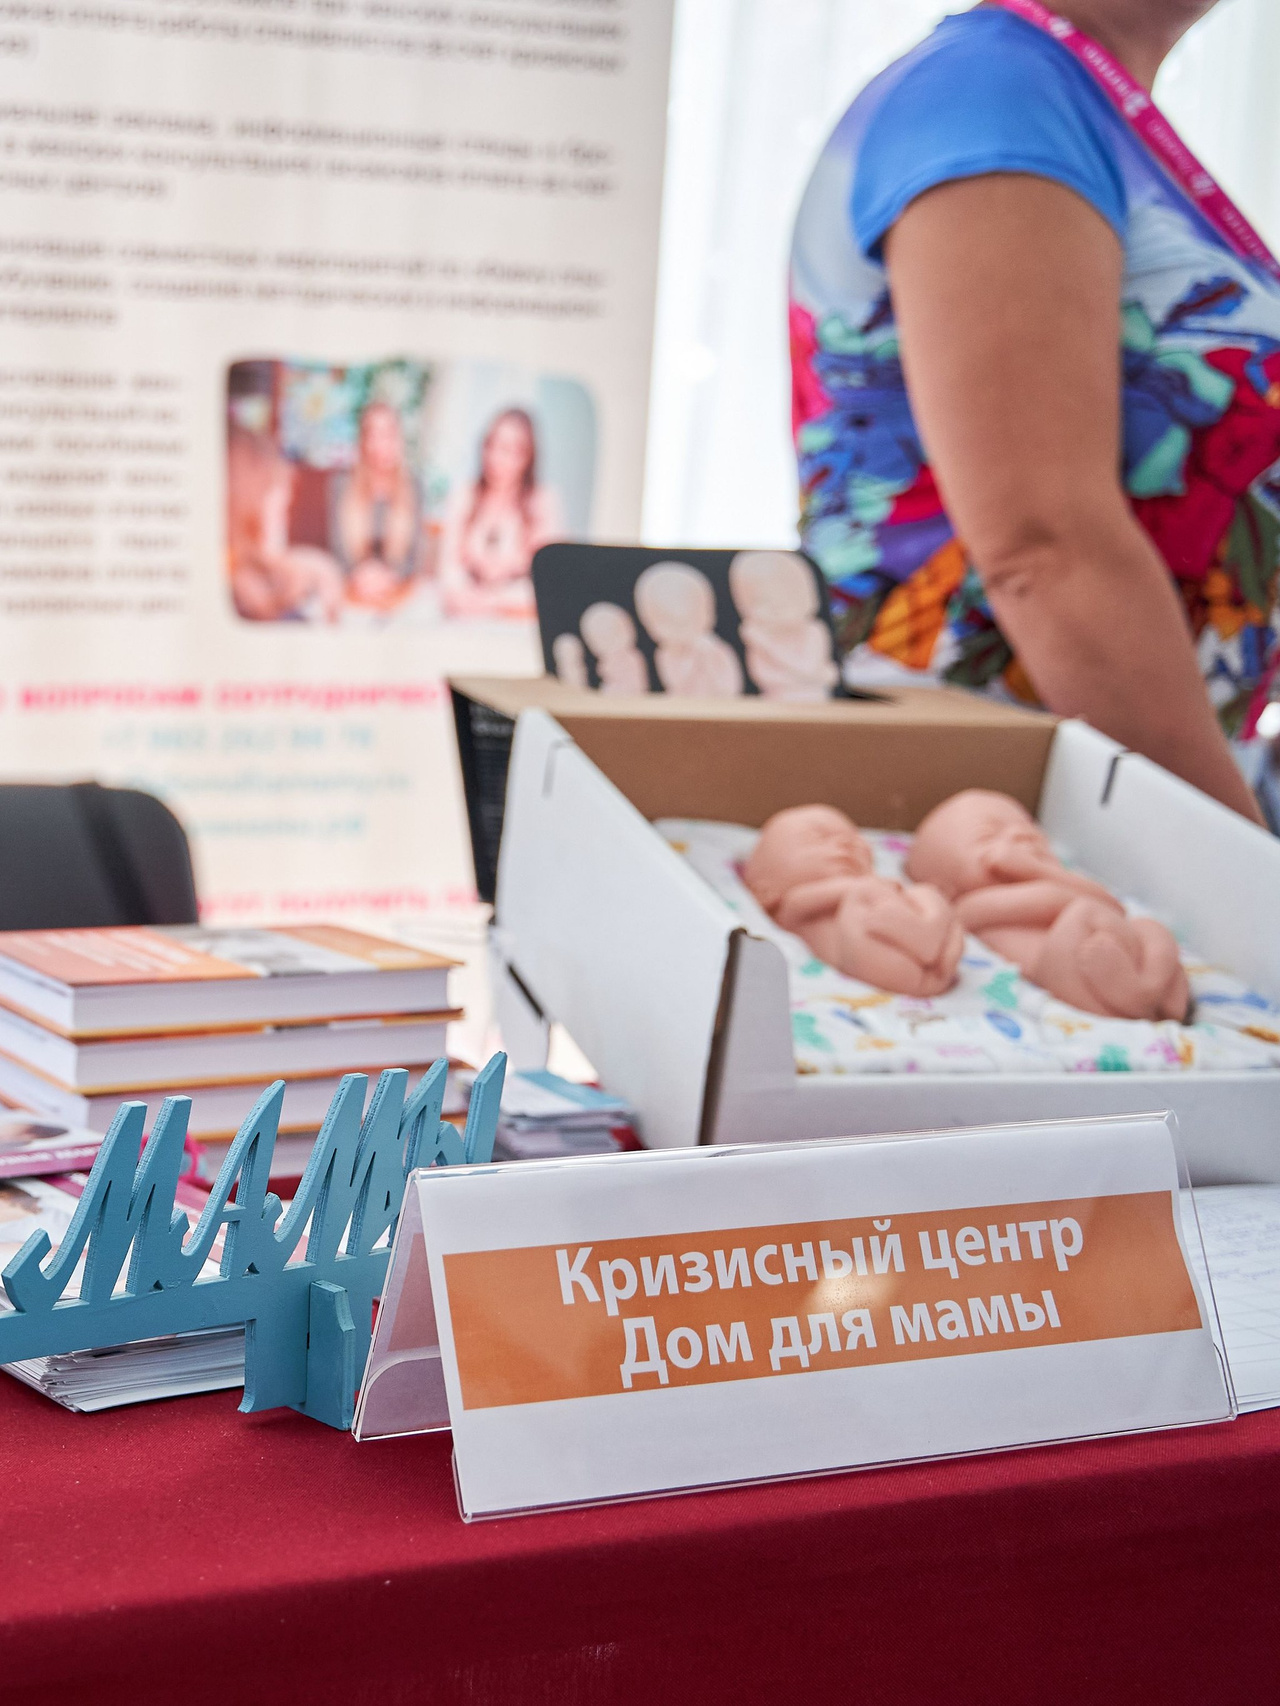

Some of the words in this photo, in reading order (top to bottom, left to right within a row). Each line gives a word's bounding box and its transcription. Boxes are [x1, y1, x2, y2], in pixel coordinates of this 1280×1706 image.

[555, 1217, 907, 1305] Кризисный
[918, 1217, 1085, 1280] центр
[619, 1315, 754, 1389] Дом
[768, 1308, 878, 1371] для
[889, 1288, 1063, 1345] мамы
